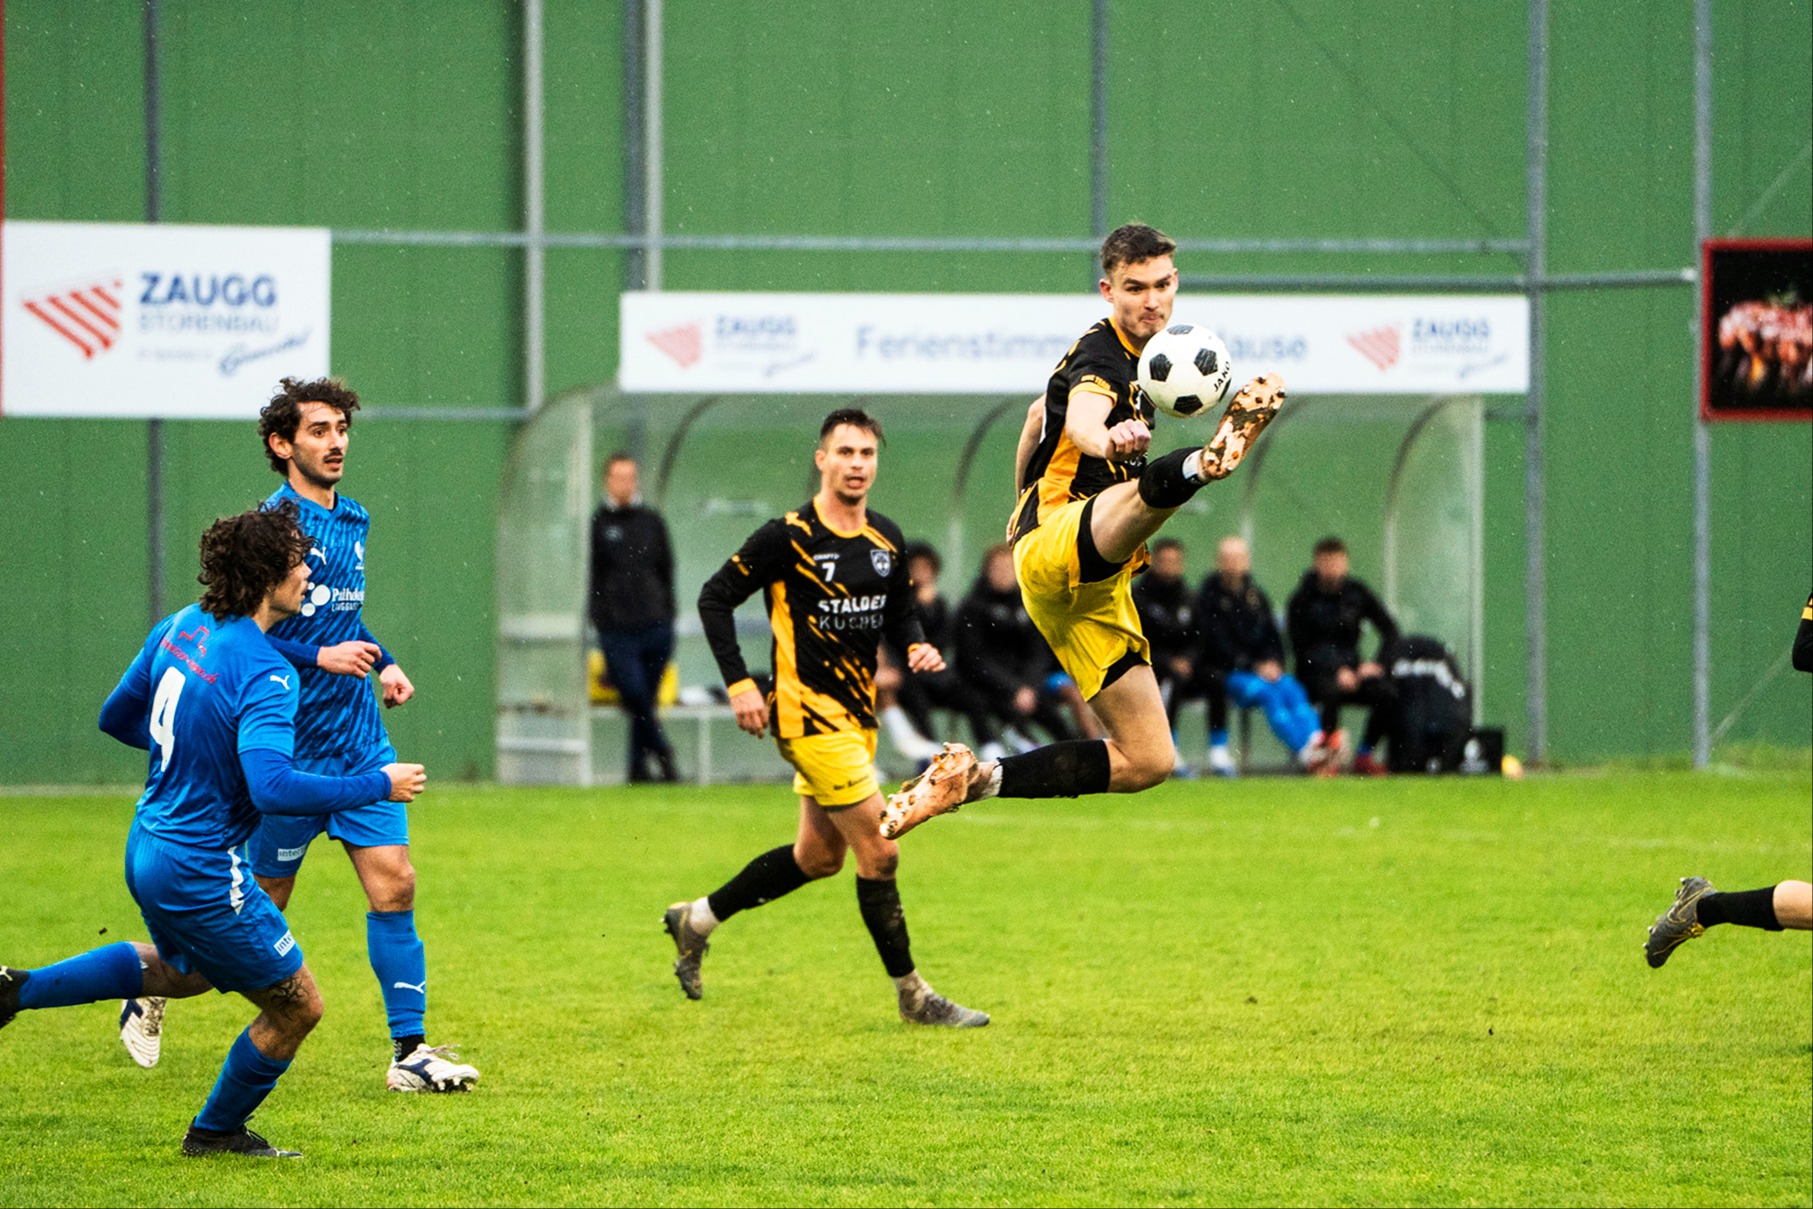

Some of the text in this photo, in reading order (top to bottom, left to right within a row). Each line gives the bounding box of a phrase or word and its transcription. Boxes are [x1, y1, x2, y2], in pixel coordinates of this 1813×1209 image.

[139, 273, 276, 307] ZAUGG
[1213, 360, 1230, 392] JAKO
[822, 562, 835, 582] 7
[149, 666, 186, 772] 4
